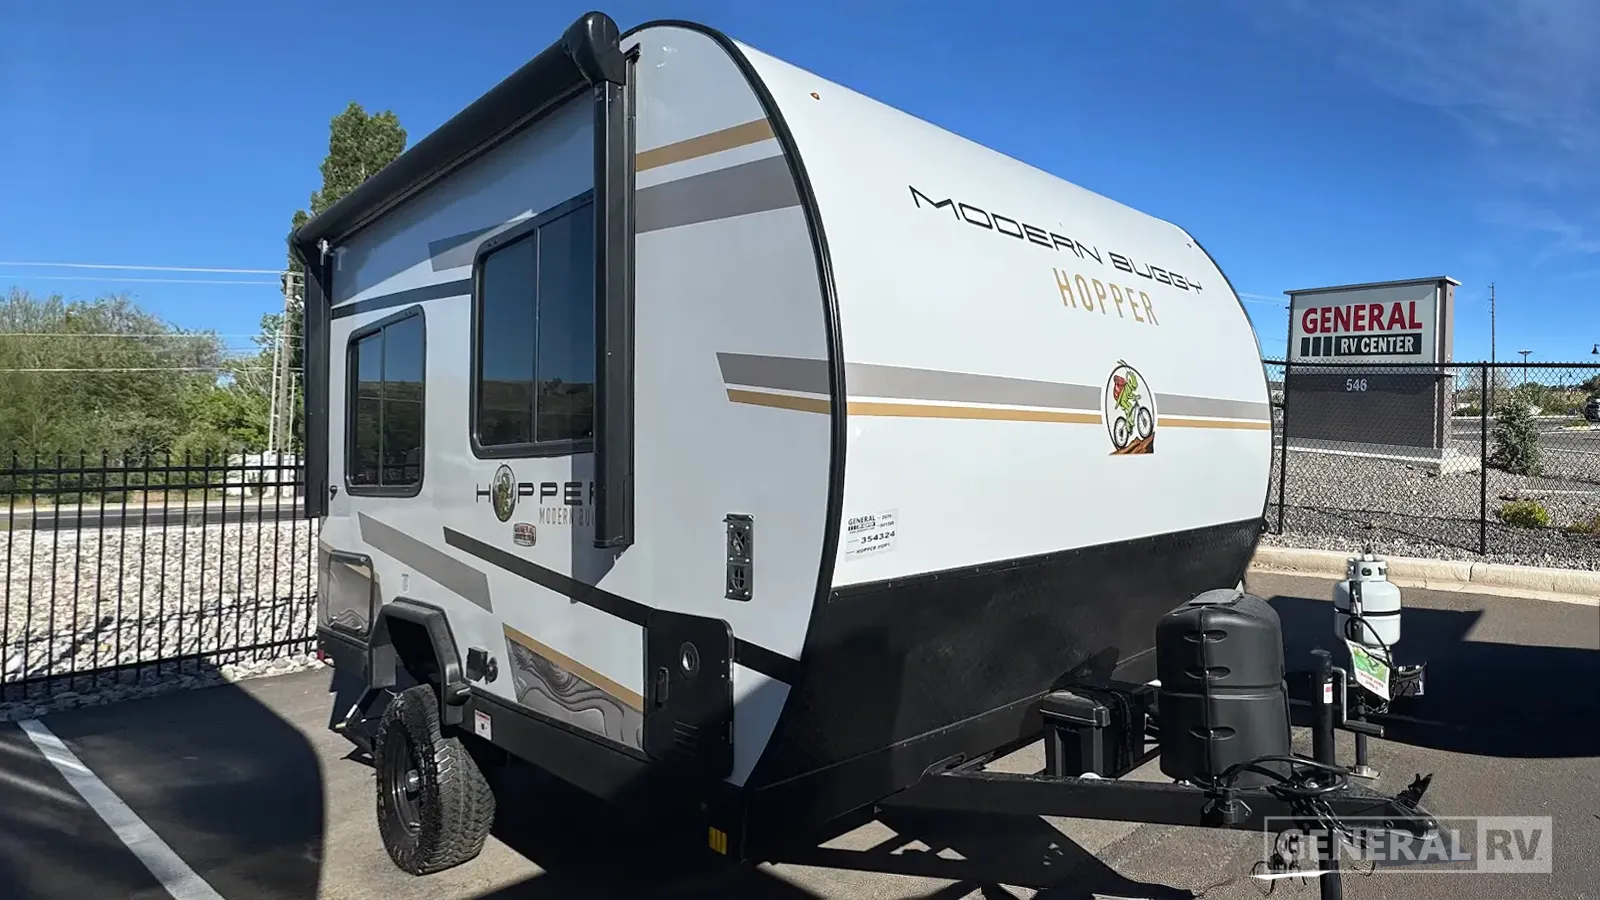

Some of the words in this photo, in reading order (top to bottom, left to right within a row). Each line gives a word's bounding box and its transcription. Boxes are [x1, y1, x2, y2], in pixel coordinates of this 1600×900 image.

[908, 184, 1103, 266] MODERN
[1108, 251, 1203, 295] BUGGY
[1052, 267, 1159, 326] HOPPER
[1301, 301, 1423, 334] GENERAL
[1340, 337, 1358, 354] RV
[1360, 336, 1414, 353] CENTER
[1346, 378, 1368, 392] 546
[539, 507, 574, 525] MODERN
[861, 531, 895, 544] 354324
